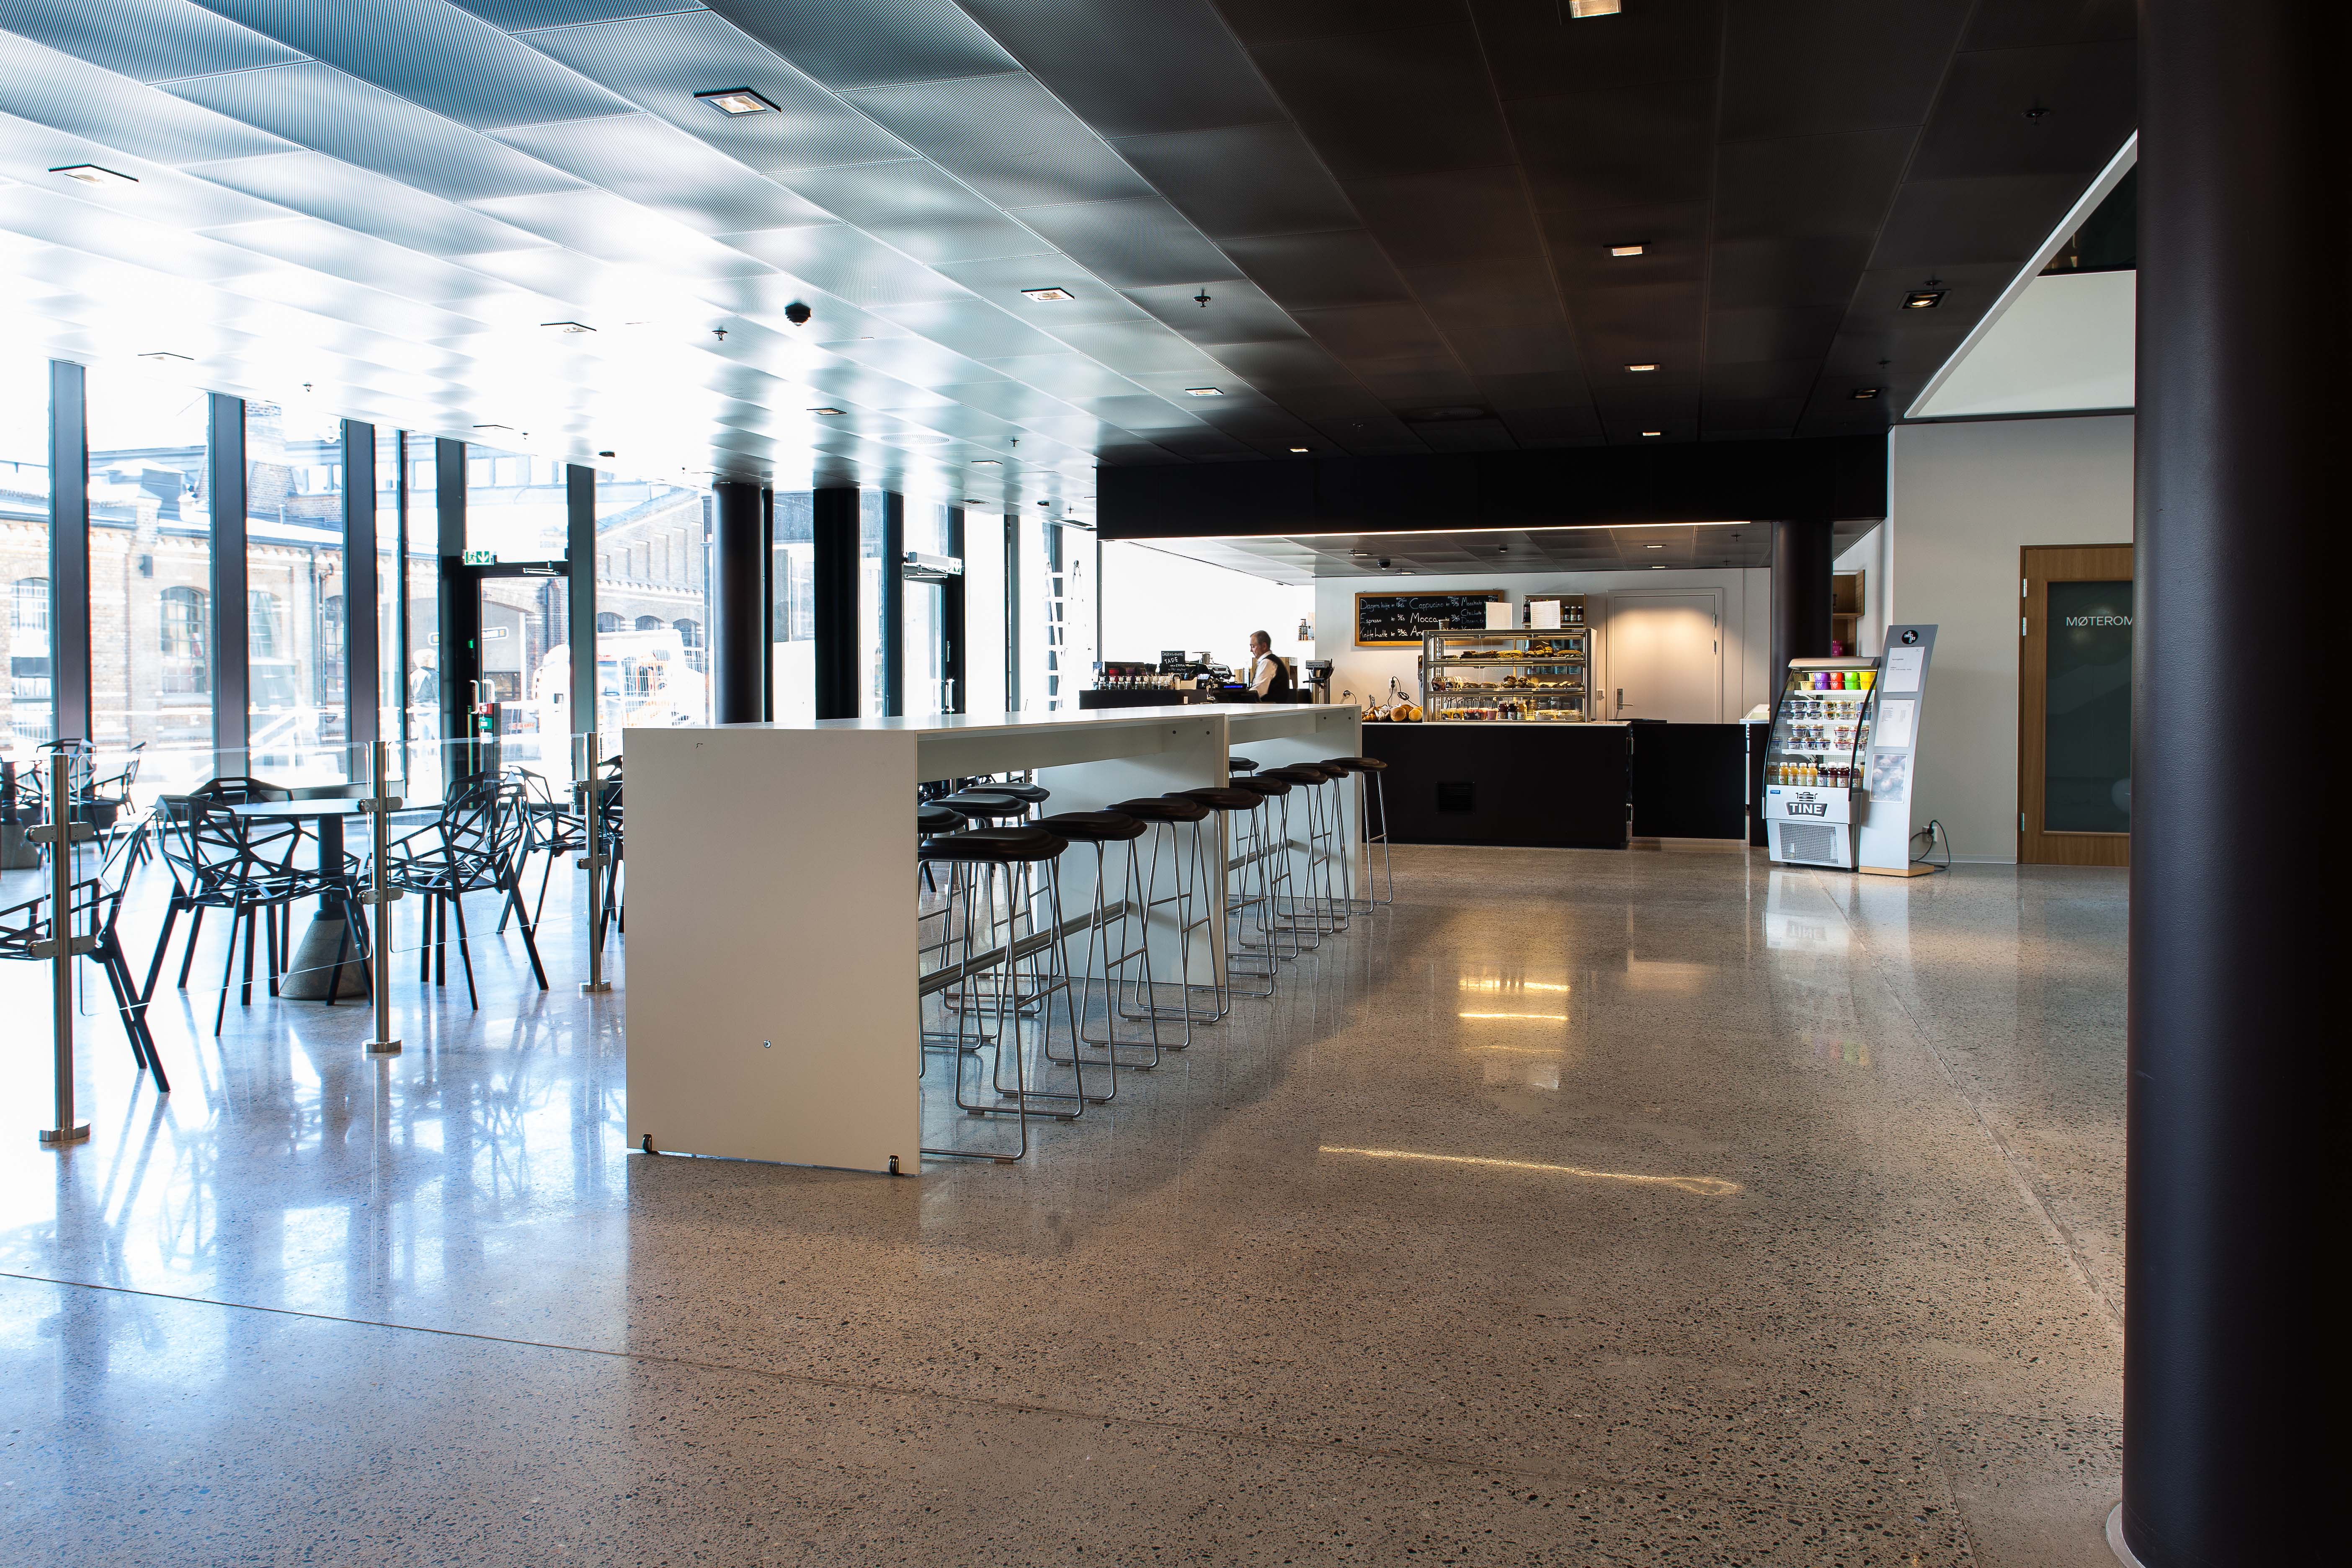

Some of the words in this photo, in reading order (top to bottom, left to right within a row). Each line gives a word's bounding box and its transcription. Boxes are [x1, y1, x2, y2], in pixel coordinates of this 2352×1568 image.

[1360, 599, 1380, 612] Dagens
[1409, 598, 1444, 611] Cappucino
[1360, 613, 1382, 626] Espresso
[1410, 613, 1438, 623] Mocca
[1789, 803, 1822, 814] TINE
